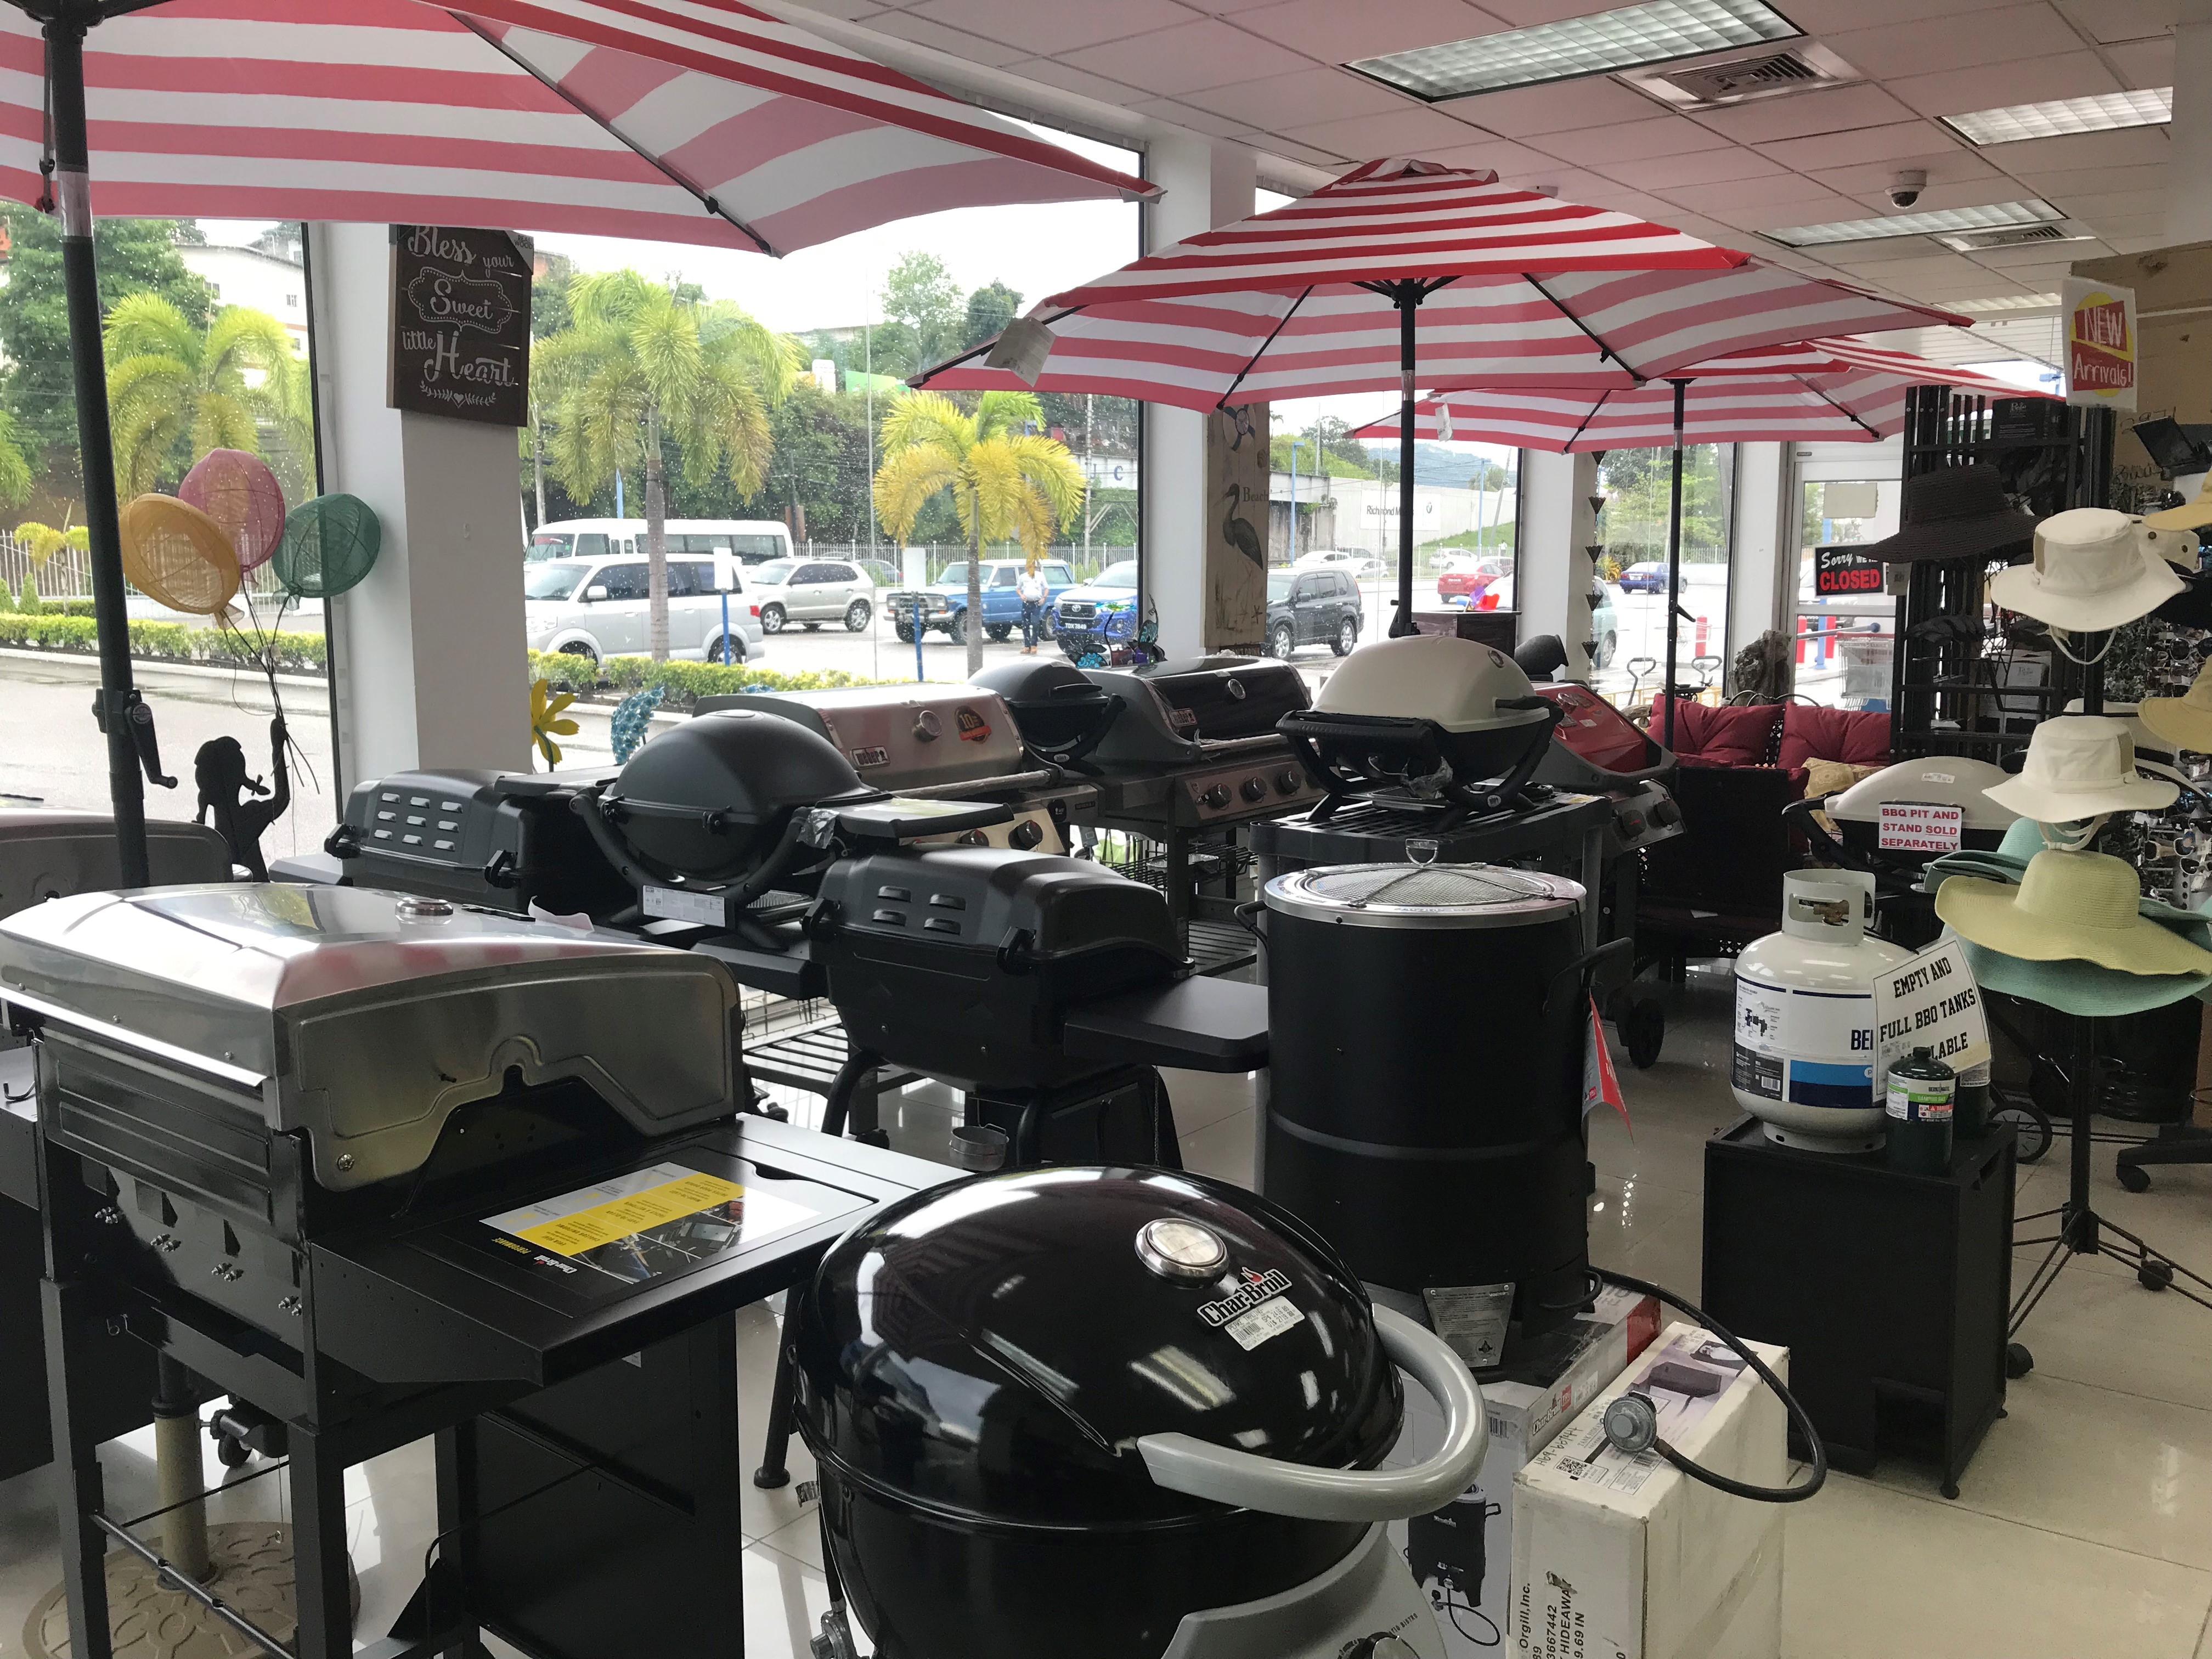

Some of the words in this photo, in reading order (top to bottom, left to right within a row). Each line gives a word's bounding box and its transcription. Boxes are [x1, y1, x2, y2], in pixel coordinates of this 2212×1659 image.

[408, 225, 476, 264] Bless
[483, 255, 515, 278] your
[430, 278, 493, 319] Sweet
[2085, 306, 2123, 347] NEW
[402, 330, 437, 351] little
[424, 330, 515, 387] Heart
[2074, 353, 2131, 387] Arrivals!
[1242, 487, 1269, 503] Beach
[1367, 505, 1395, 516] Richmond
[1821, 552, 1853, 569] Sorry
[1819, 568, 1880, 591] CLOSED
[1882, 808, 1907, 817] BBQ
[1910, 809, 1929, 819] PIT
[1933, 811, 1959, 820] AND
[1883, 823, 1922, 833] STAND
[1926, 825, 1957, 835] SOLD
[1881, 838, 1959, 850] SEPARATELY
[1893, 967, 1930, 998] EMPTY
[1929, 957, 1952, 981] AND
[1880, 1017, 1912, 1043] FULL
[1939, 988, 1976, 1019] TANKS
[1198, 1269, 1292, 1326] Char-Broil
[1400, 1613, 1418, 1628] BISTRO
